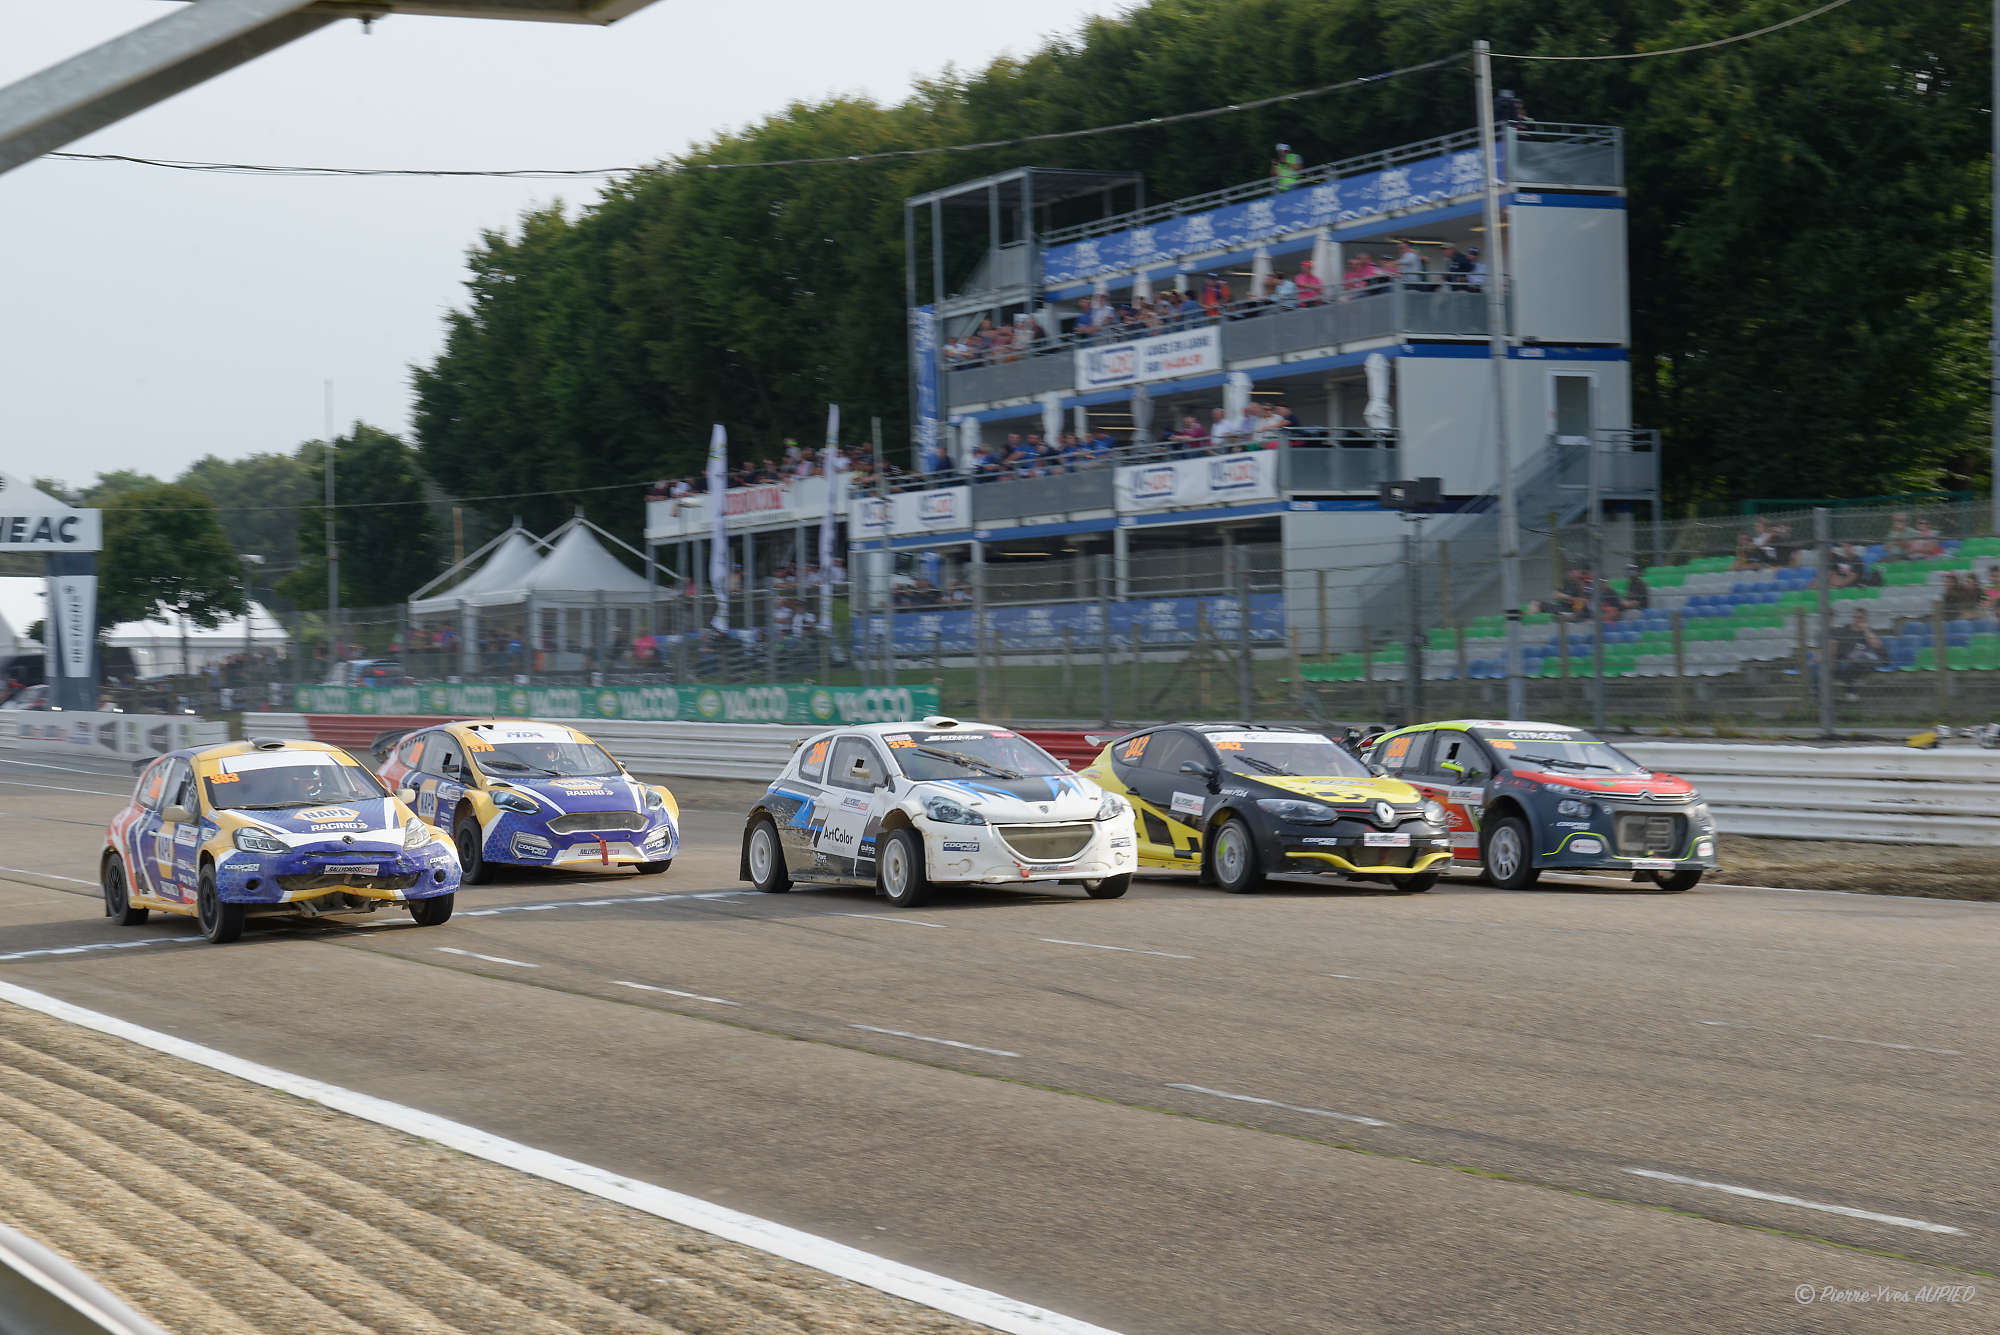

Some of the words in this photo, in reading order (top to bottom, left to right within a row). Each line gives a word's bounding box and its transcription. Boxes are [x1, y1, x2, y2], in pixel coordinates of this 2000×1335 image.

[564, 789, 606, 797] RACING
[302, 808, 353, 820] NAPA
[311, 822, 358, 832] RACING
[823, 826, 854, 845] ArtColor
[518, 843, 548, 853] COOPER
